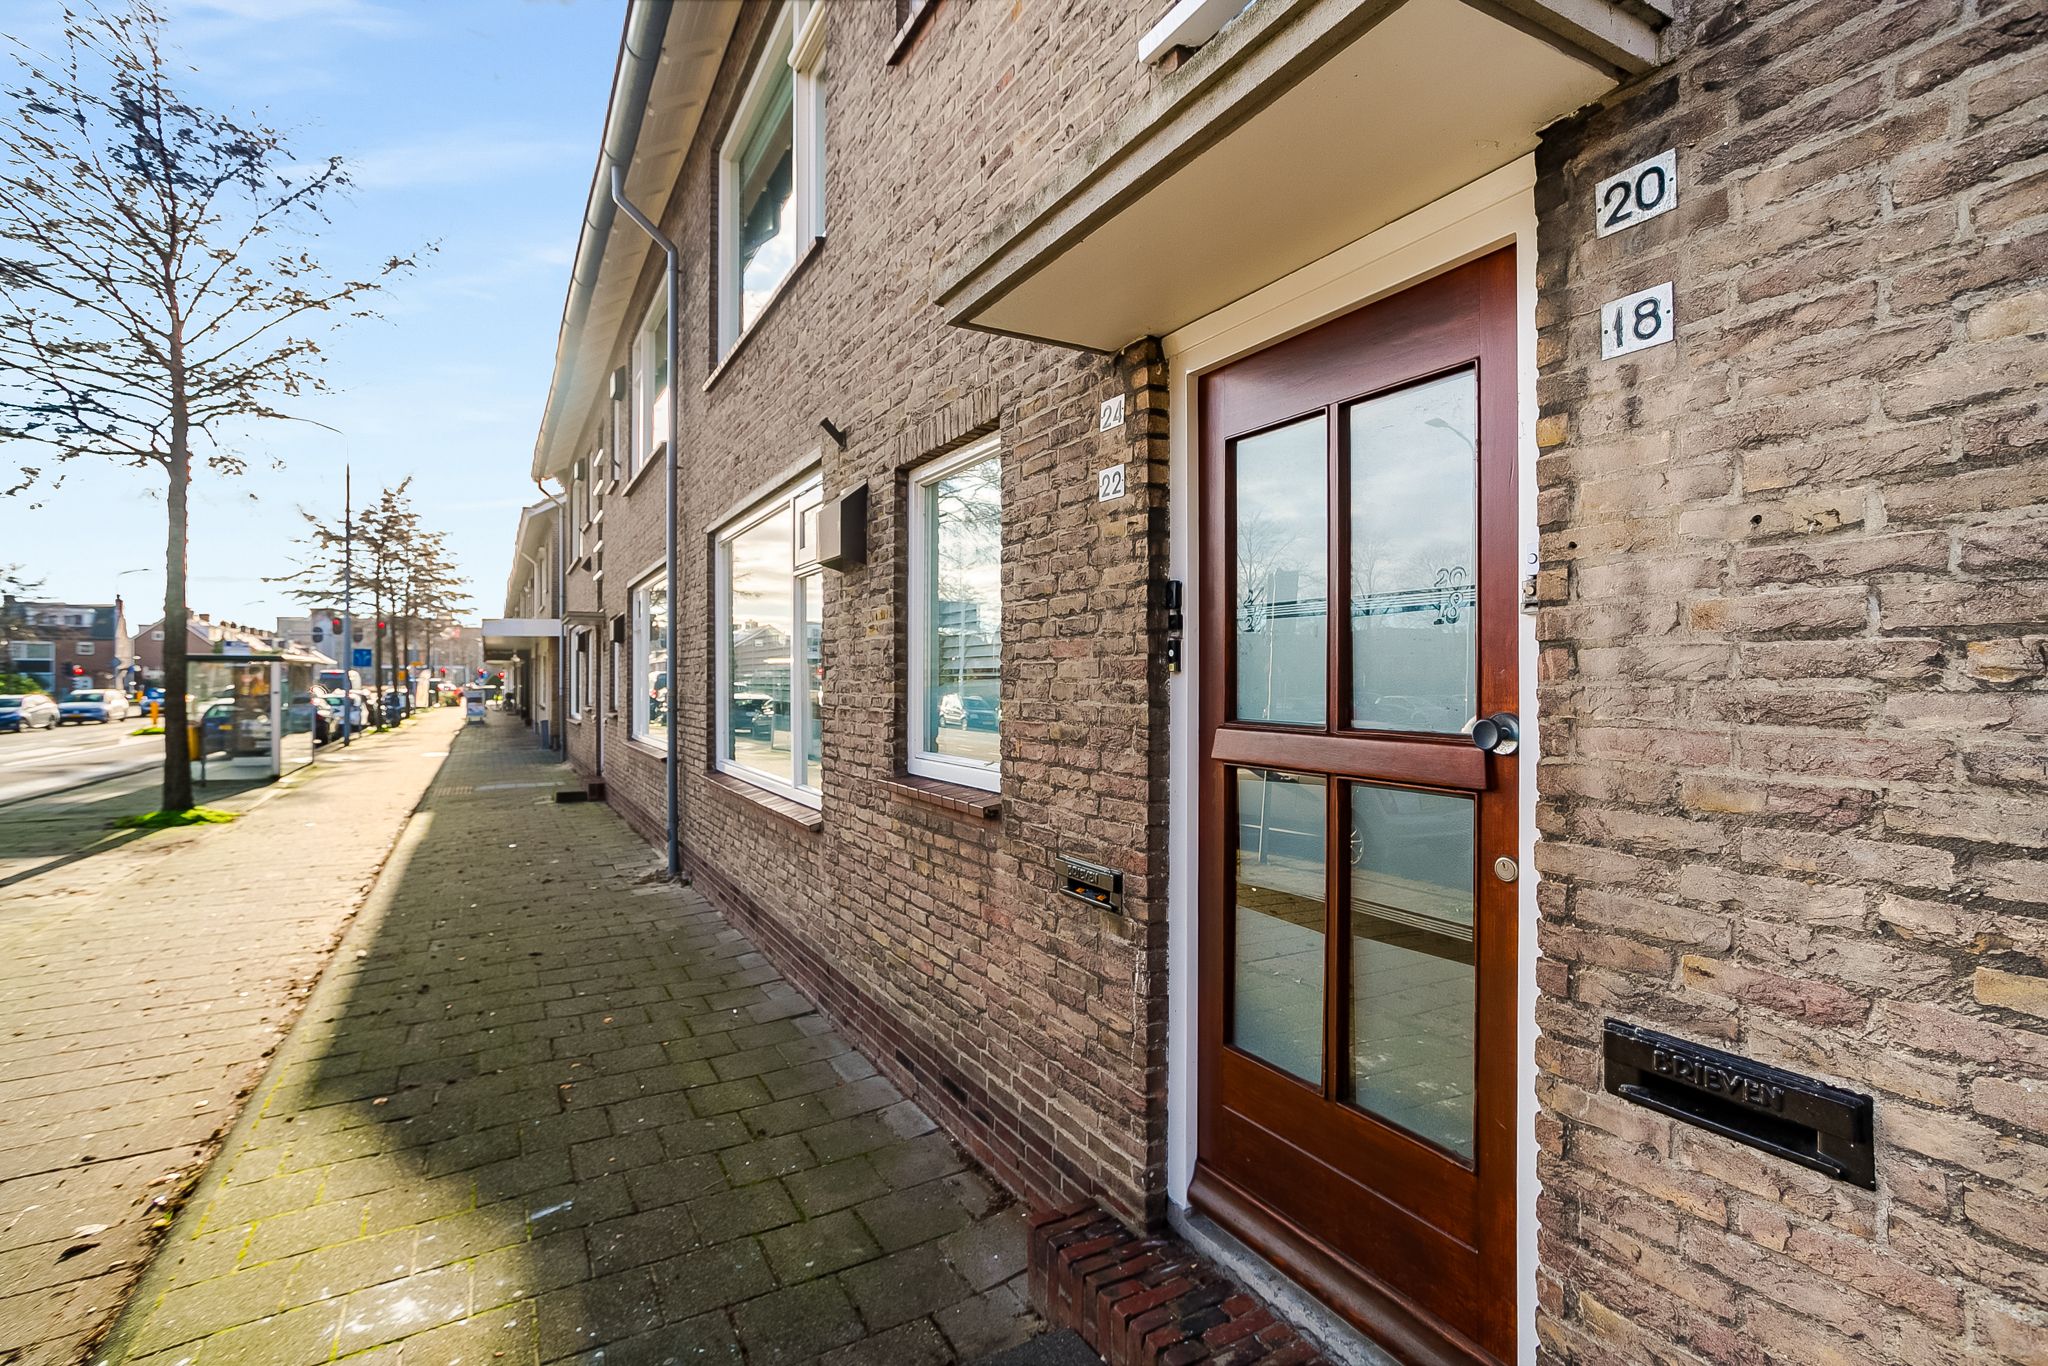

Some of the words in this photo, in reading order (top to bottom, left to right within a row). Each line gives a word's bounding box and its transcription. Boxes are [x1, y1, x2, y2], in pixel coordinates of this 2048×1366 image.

[1604, 166, 1665, 227] 20
[1613, 299, 1662, 348] 18
[1102, 400, 1122, 429] 24
[1101, 471, 1121, 497] 22
[1433, 566, 1467, 590] 20
[1432, 592, 1464, 624] 18
[1653, 1050, 1785, 1112] BRIEVEN
